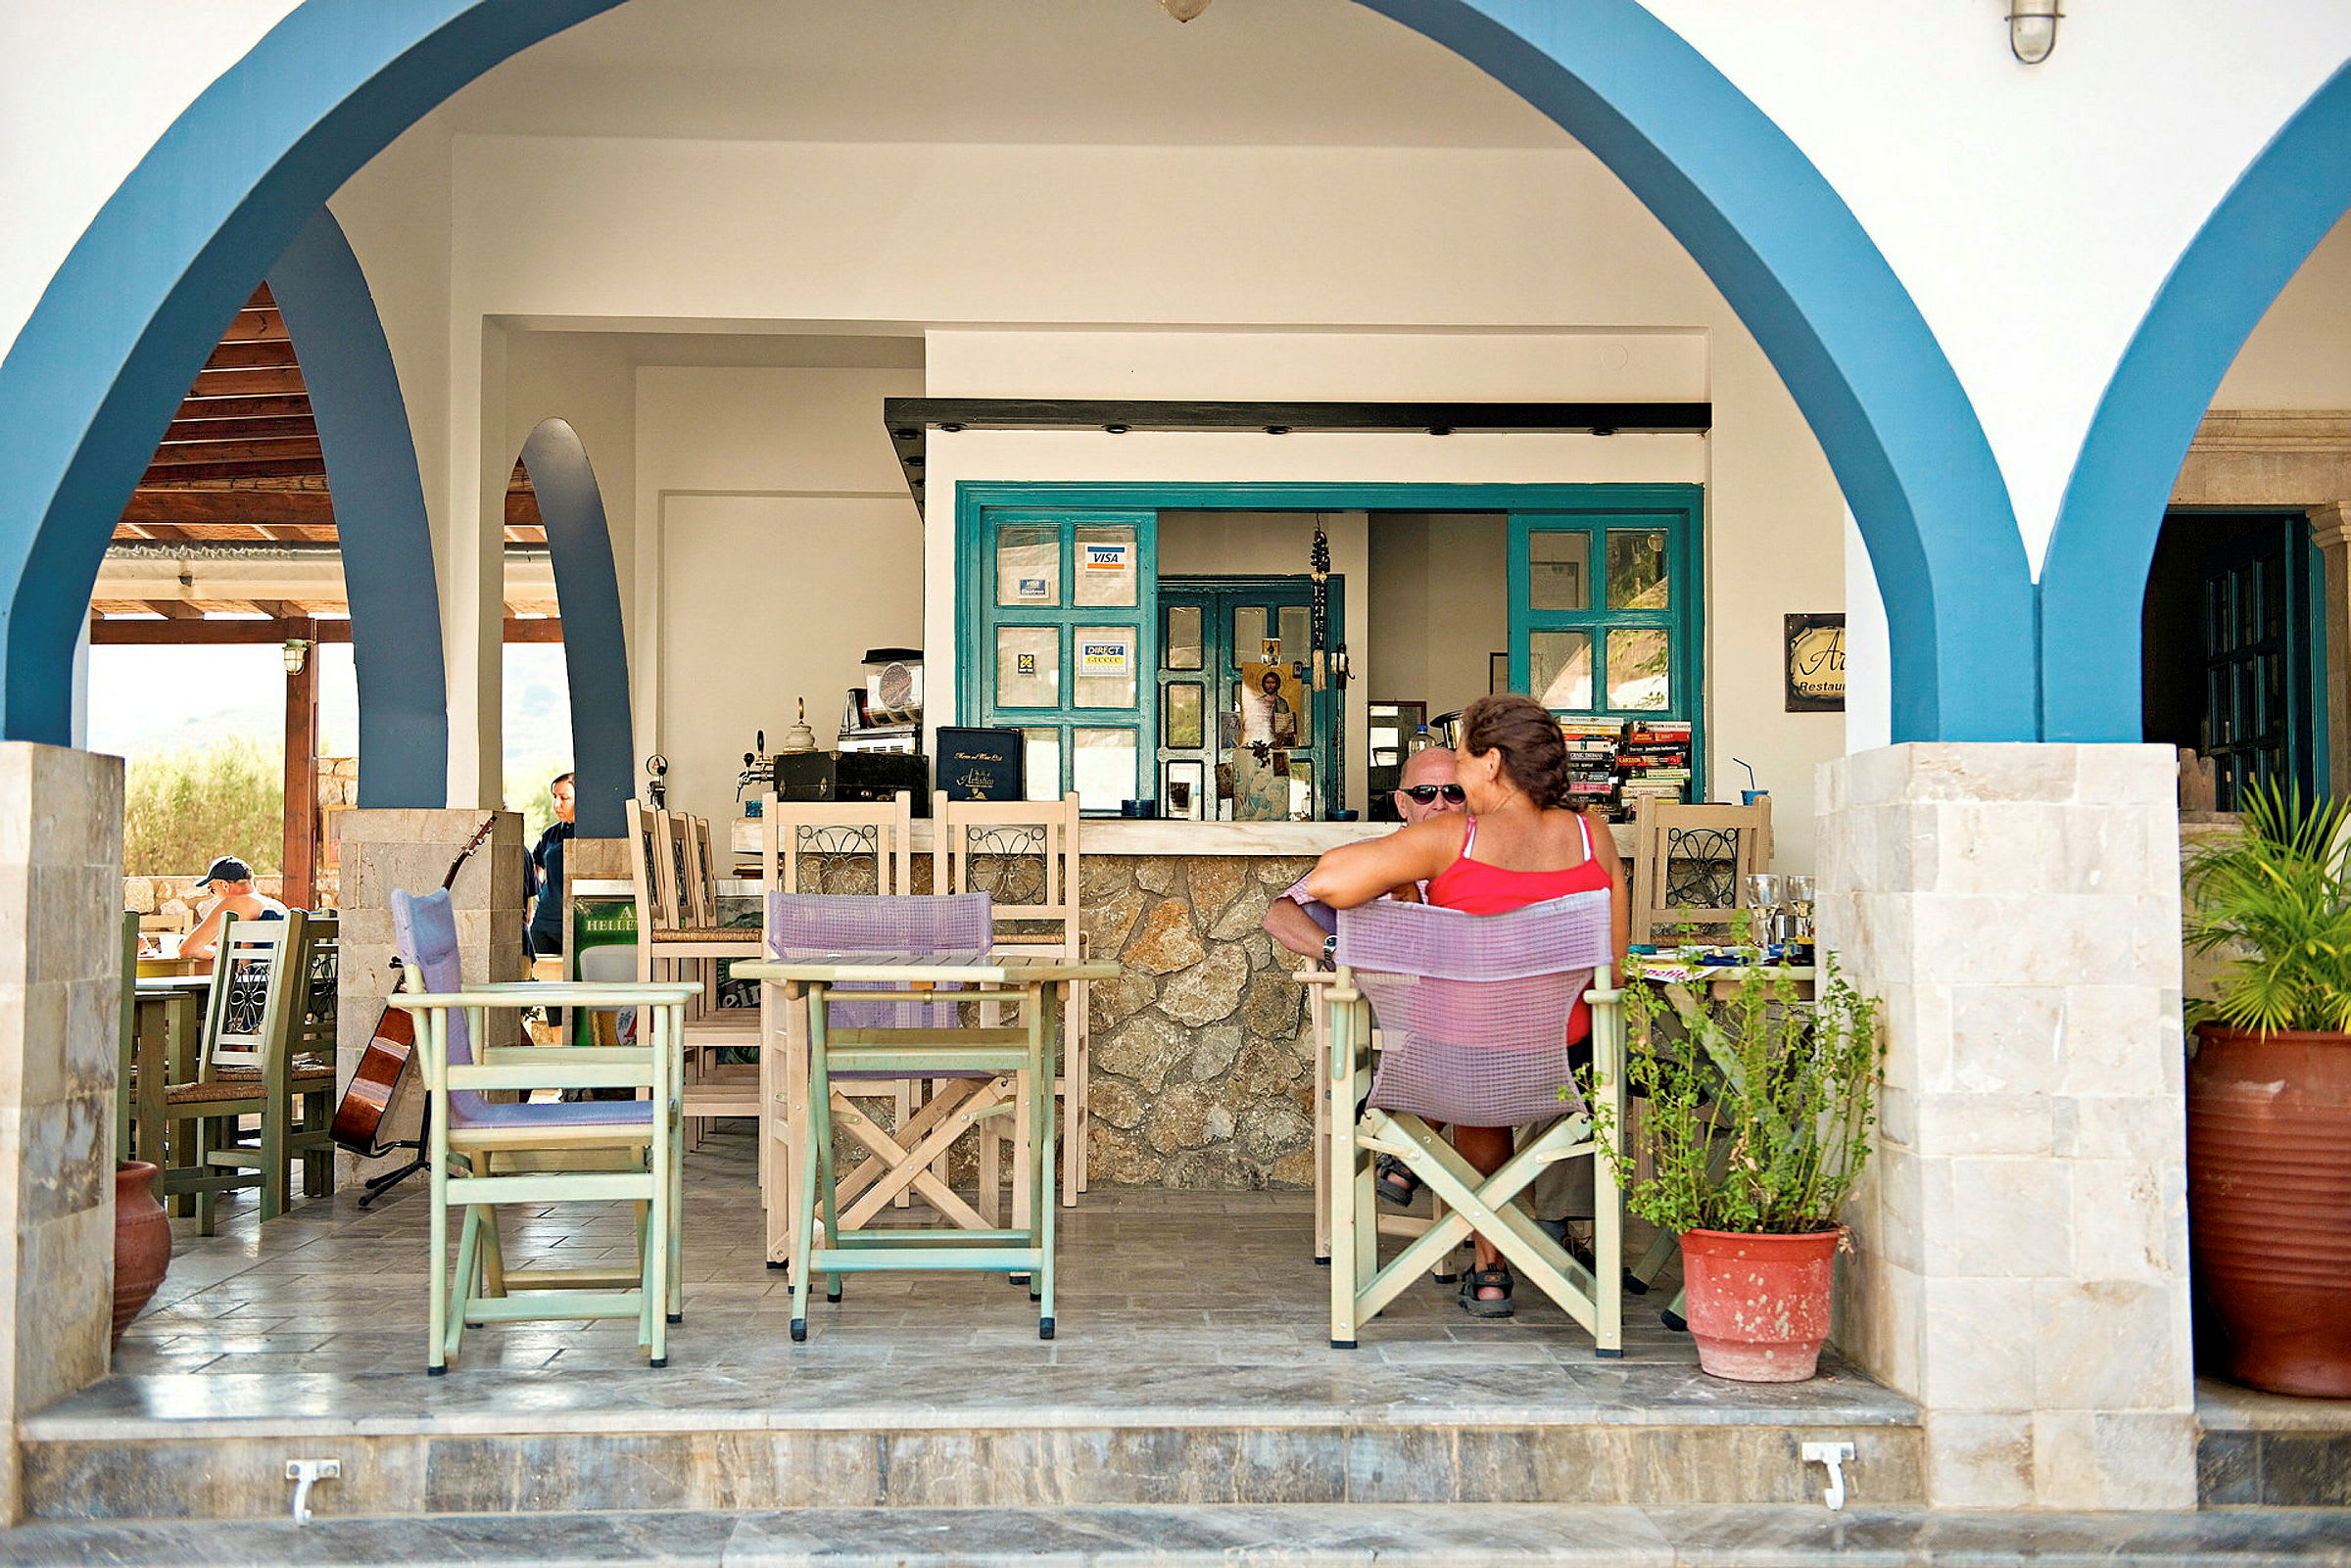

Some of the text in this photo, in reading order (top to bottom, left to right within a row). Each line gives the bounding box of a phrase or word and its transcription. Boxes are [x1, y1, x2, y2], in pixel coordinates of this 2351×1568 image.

[1093, 552, 1119, 563] VISA
[1087, 646, 1121, 655] DIRECT
[1799, 681, 1847, 691] Restau
[587, 920, 639, 932] HELLE
